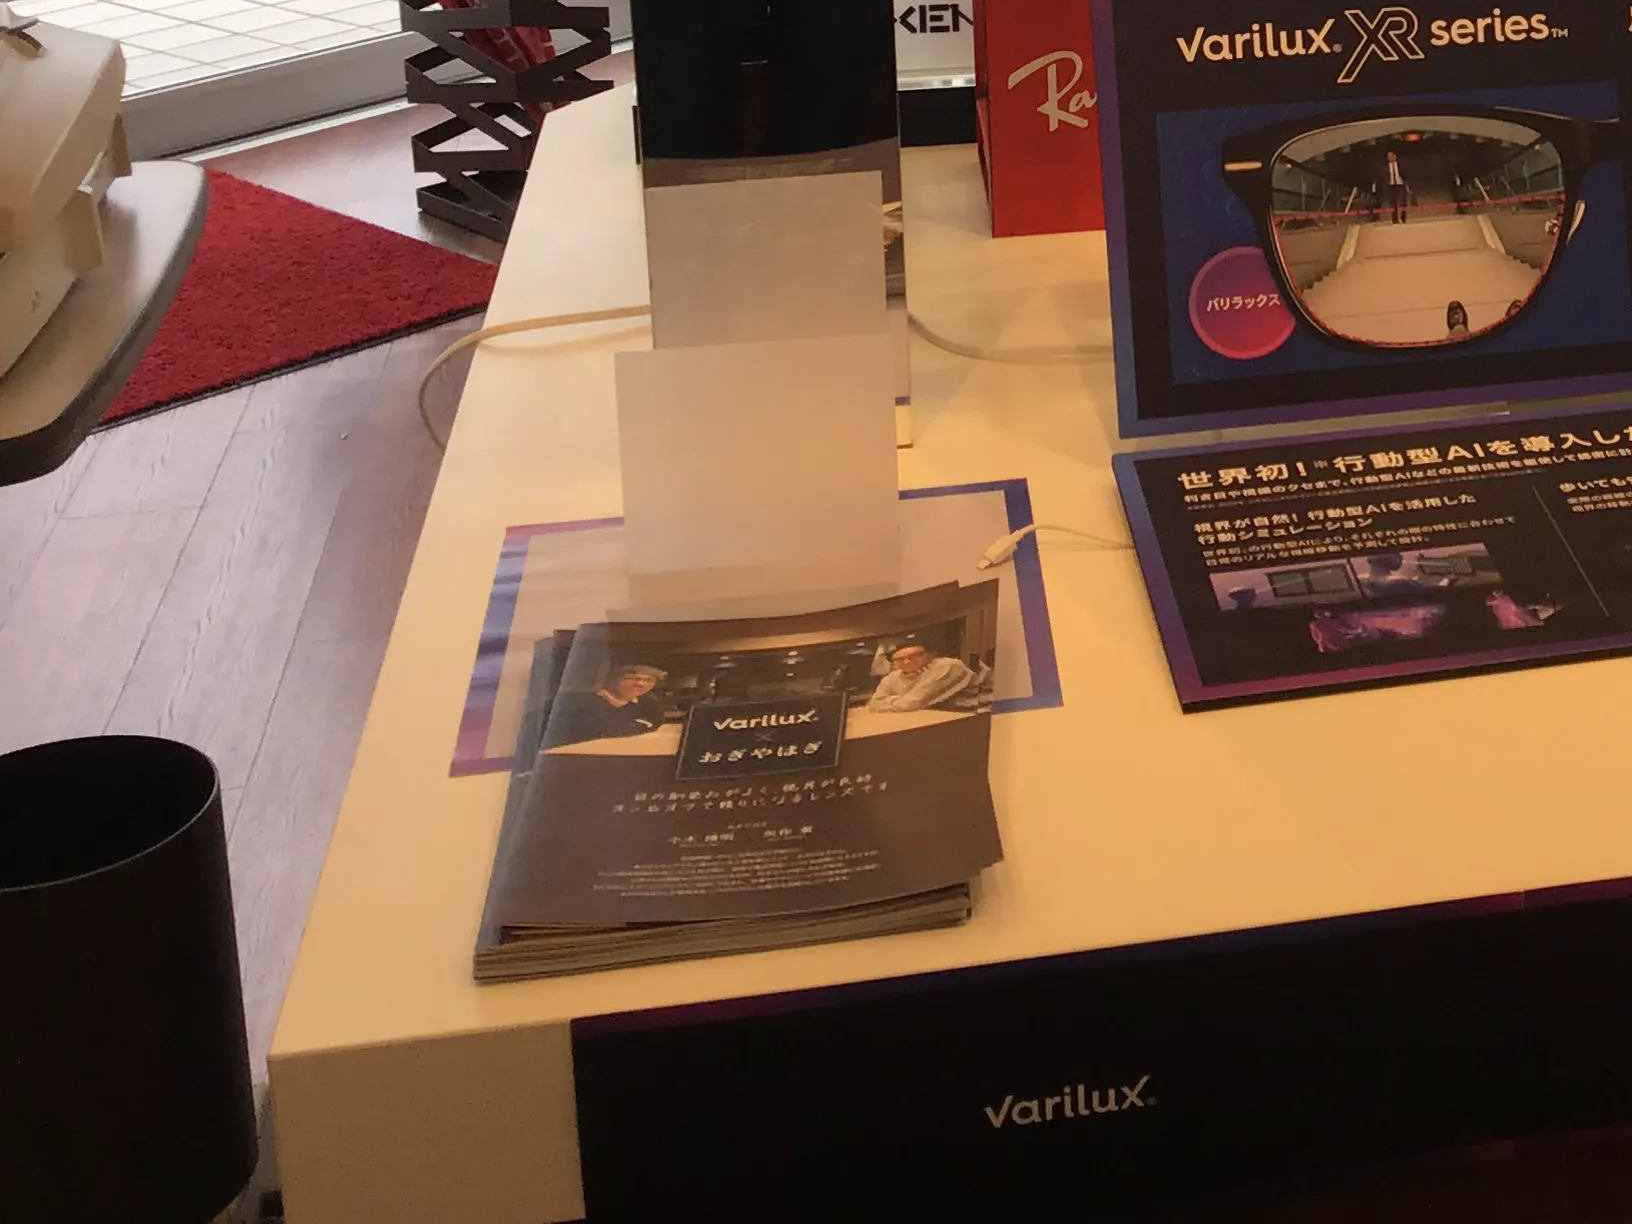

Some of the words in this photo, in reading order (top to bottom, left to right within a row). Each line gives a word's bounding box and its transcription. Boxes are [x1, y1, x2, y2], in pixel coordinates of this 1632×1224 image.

[1206, 292, 1281, 312] バリラックス
[1196, 517, 1373, 546] 行動シミュレーション
[699, 740, 824, 765] おぎやはぎ
